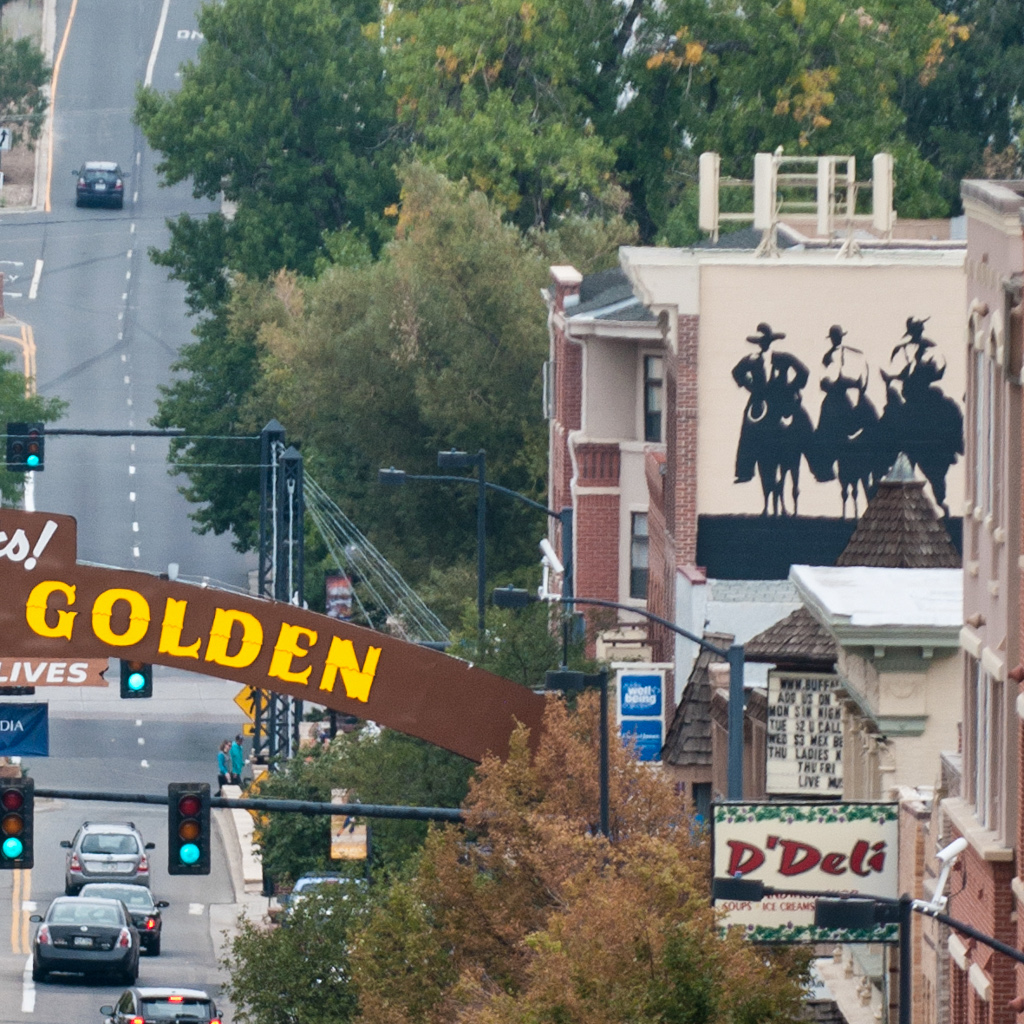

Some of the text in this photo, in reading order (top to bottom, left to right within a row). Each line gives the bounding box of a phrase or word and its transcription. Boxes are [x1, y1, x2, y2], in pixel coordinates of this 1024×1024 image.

[26, 580, 382, 703] GOLDEN
[628, 685, 652, 695] well
[624, 693, 657, 706] being
[819, 694, 830, 705] ON
[768, 705, 788, 716] MON
[770, 720, 787, 731] TUE
[819, 722, 842, 734] CALL
[769, 747, 787, 758] THU
[796, 747, 829, 760] LADIES
[798, 762, 835, 773] THU FRI
[798, 775, 820, 788] LIVE
[726, 834, 887, 877] D'Deli
[722, 901, 816, 912] SOUPS ICE CREAMS
